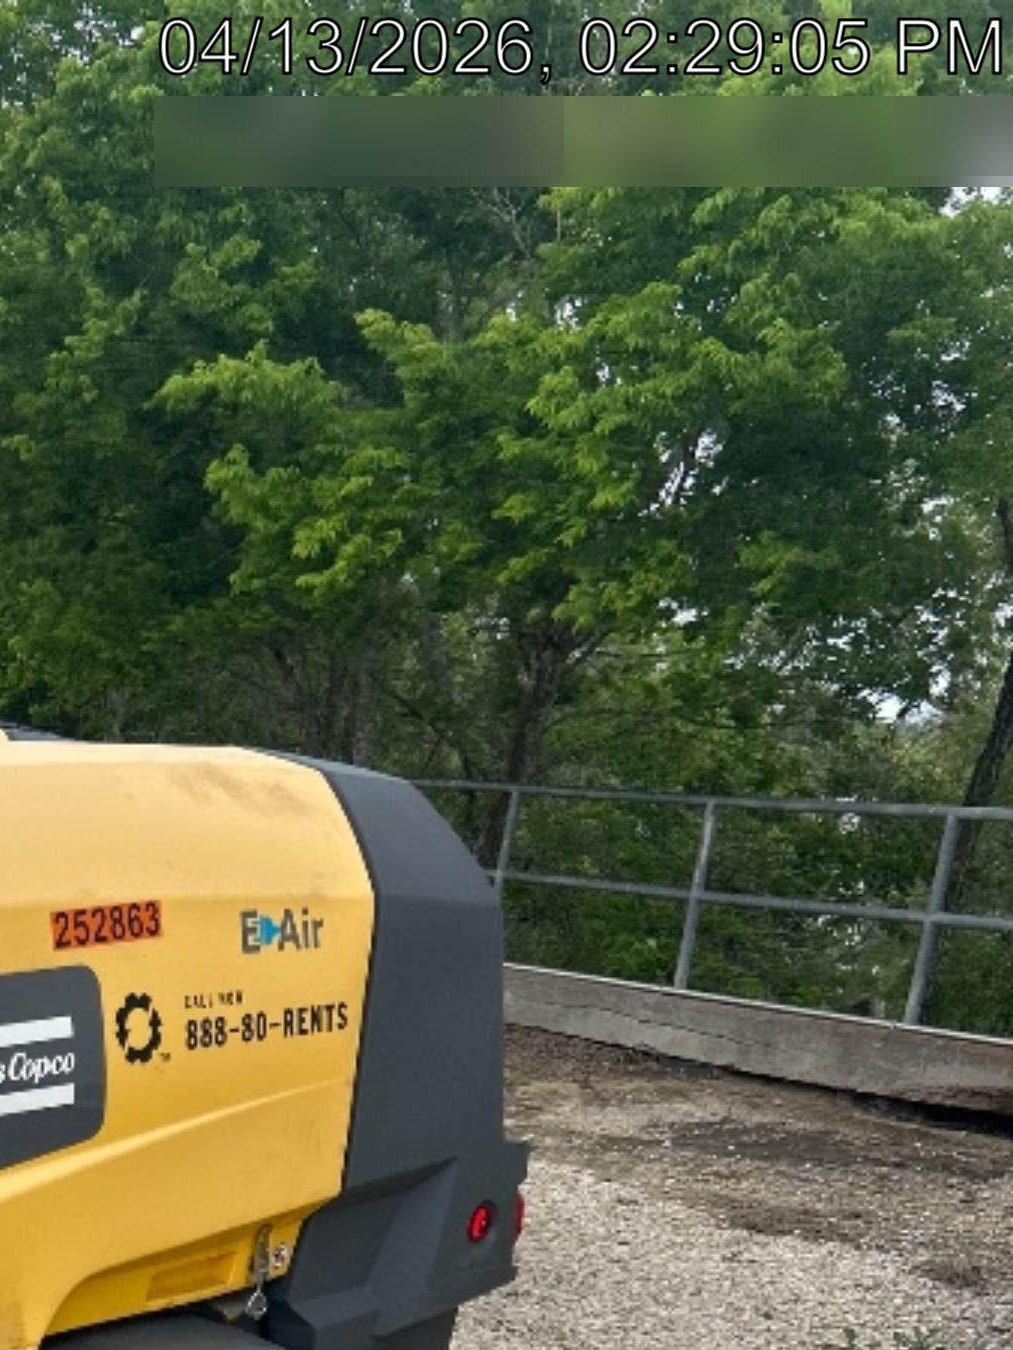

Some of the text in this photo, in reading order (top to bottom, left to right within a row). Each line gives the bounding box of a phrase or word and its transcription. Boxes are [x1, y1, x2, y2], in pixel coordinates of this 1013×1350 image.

[54, 902, 161, 949] 252863
[186, 1001, 348, 1050] 888-80-RENTS
[7, 1052, 76, 1084] Copco
